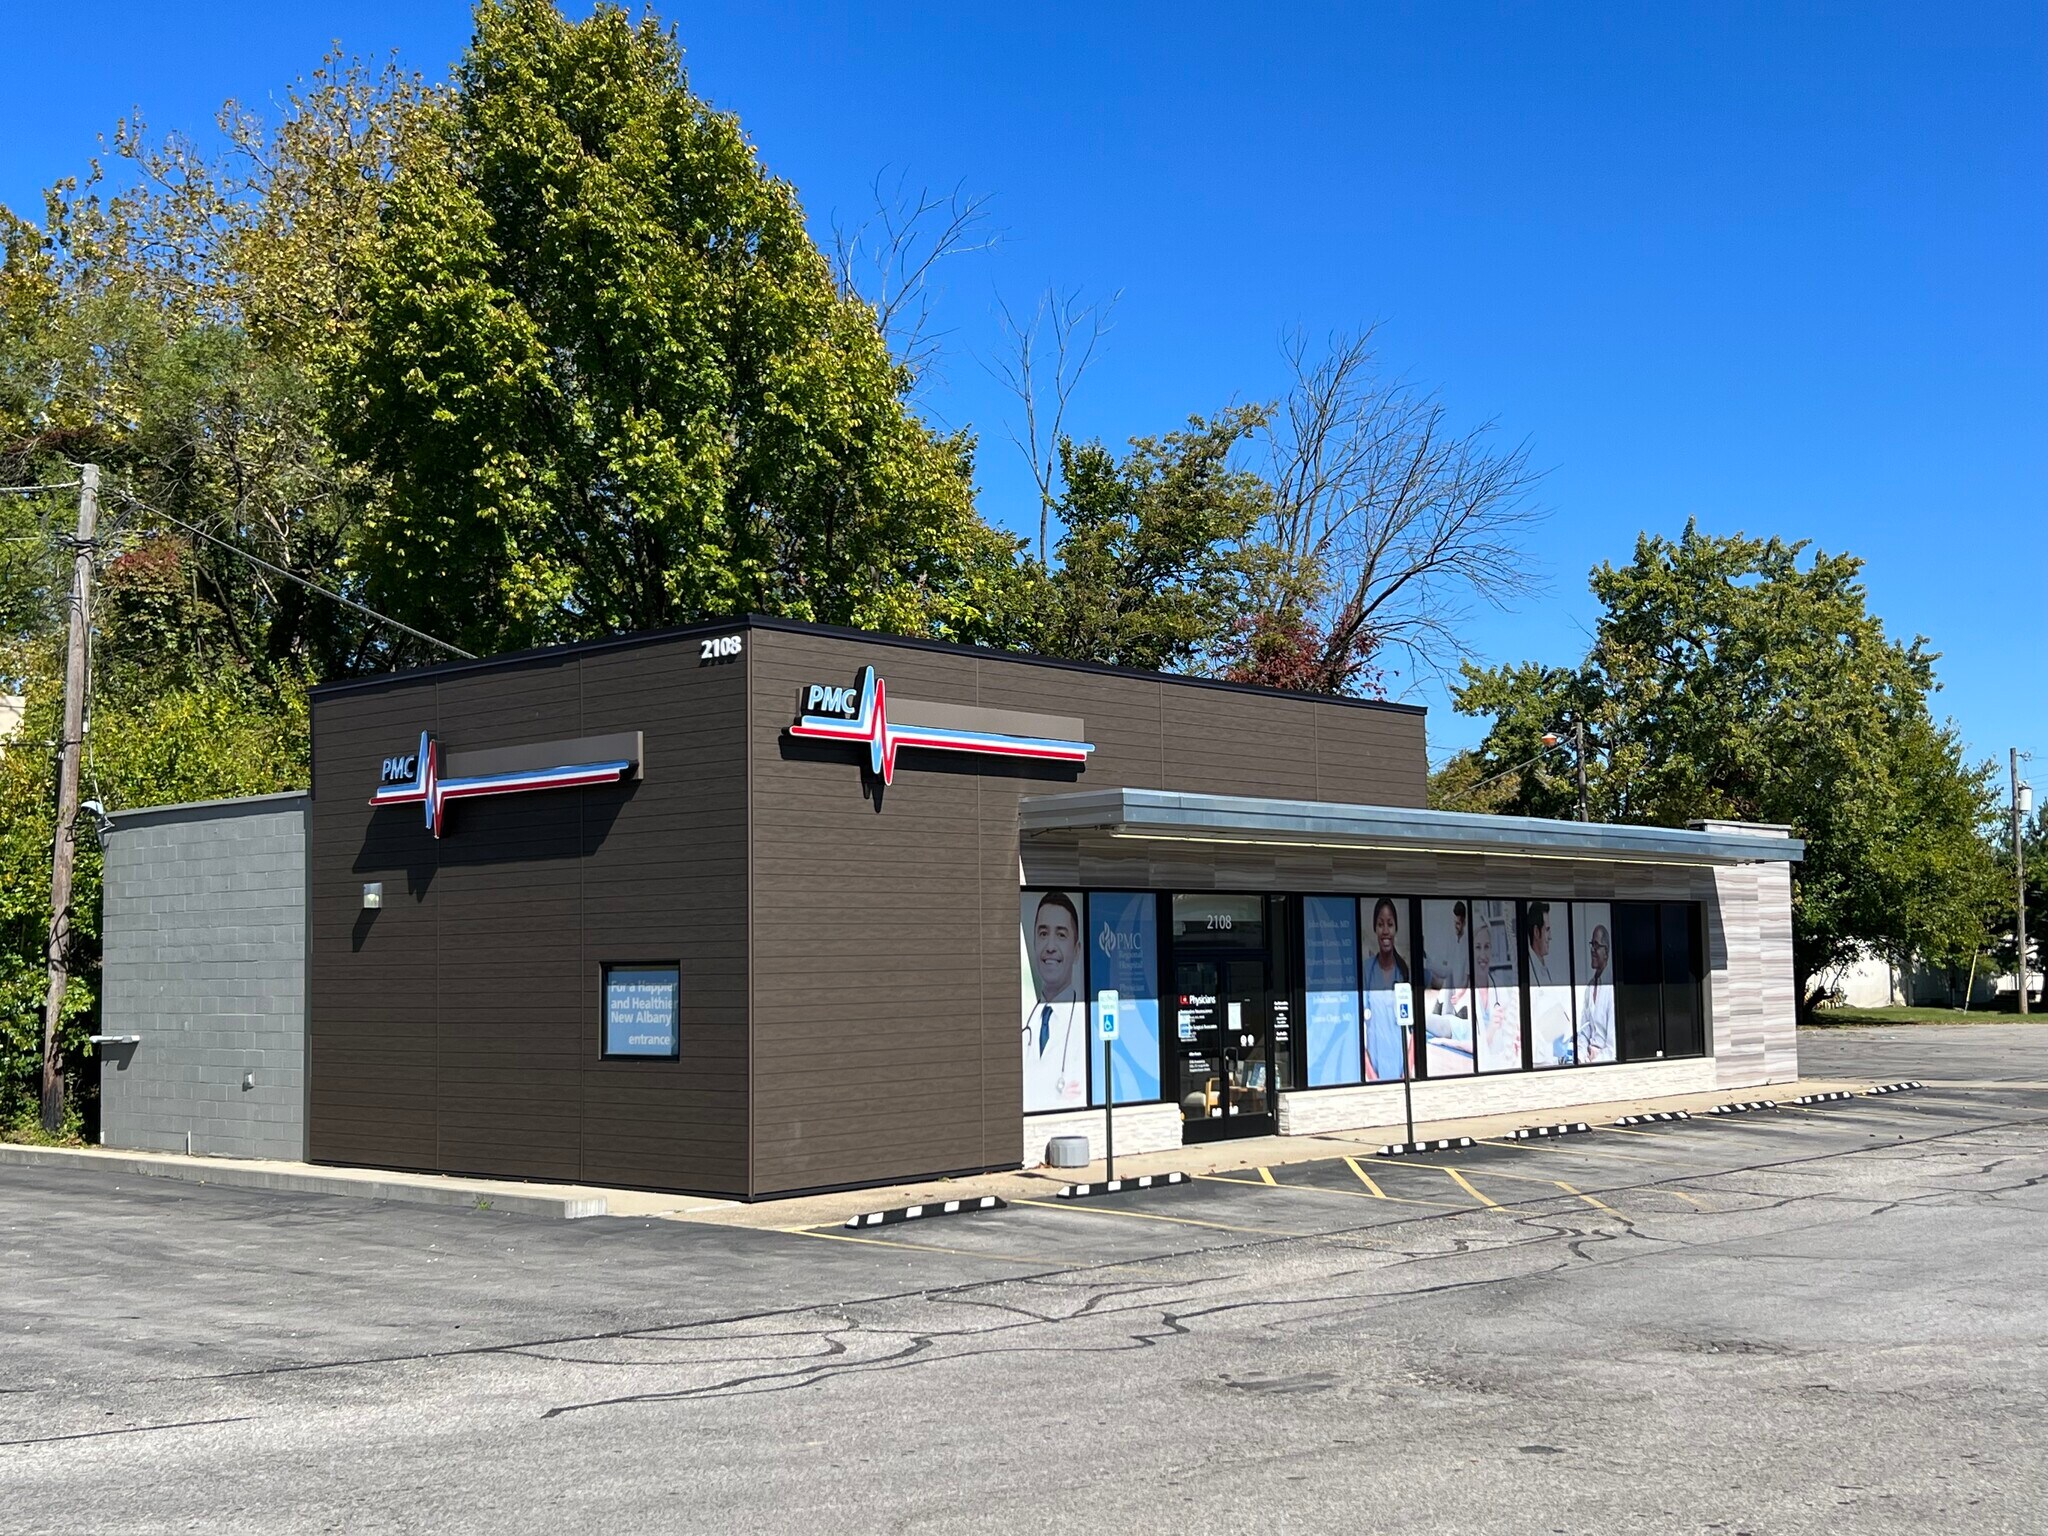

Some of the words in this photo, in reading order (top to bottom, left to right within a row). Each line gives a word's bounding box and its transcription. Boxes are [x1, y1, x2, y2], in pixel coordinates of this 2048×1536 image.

[701, 635, 742, 659] 2108
[808, 685, 857, 713] PMC
[381, 755, 415, 781] PMC
[1207, 914, 1232, 930] 2108
[1116, 932, 1142, 950] PMC
[611, 980, 627, 993] For
[629, 984, 636, 992] a
[638, 979, 677, 996] Happier
[611, 997, 630, 1009] and
[633, 997, 678, 1010] Healthier
[1189, 994, 1216, 1006] Physicians
[611, 1011, 634, 1024] New
[628, 1034, 670, 1045] entrance
